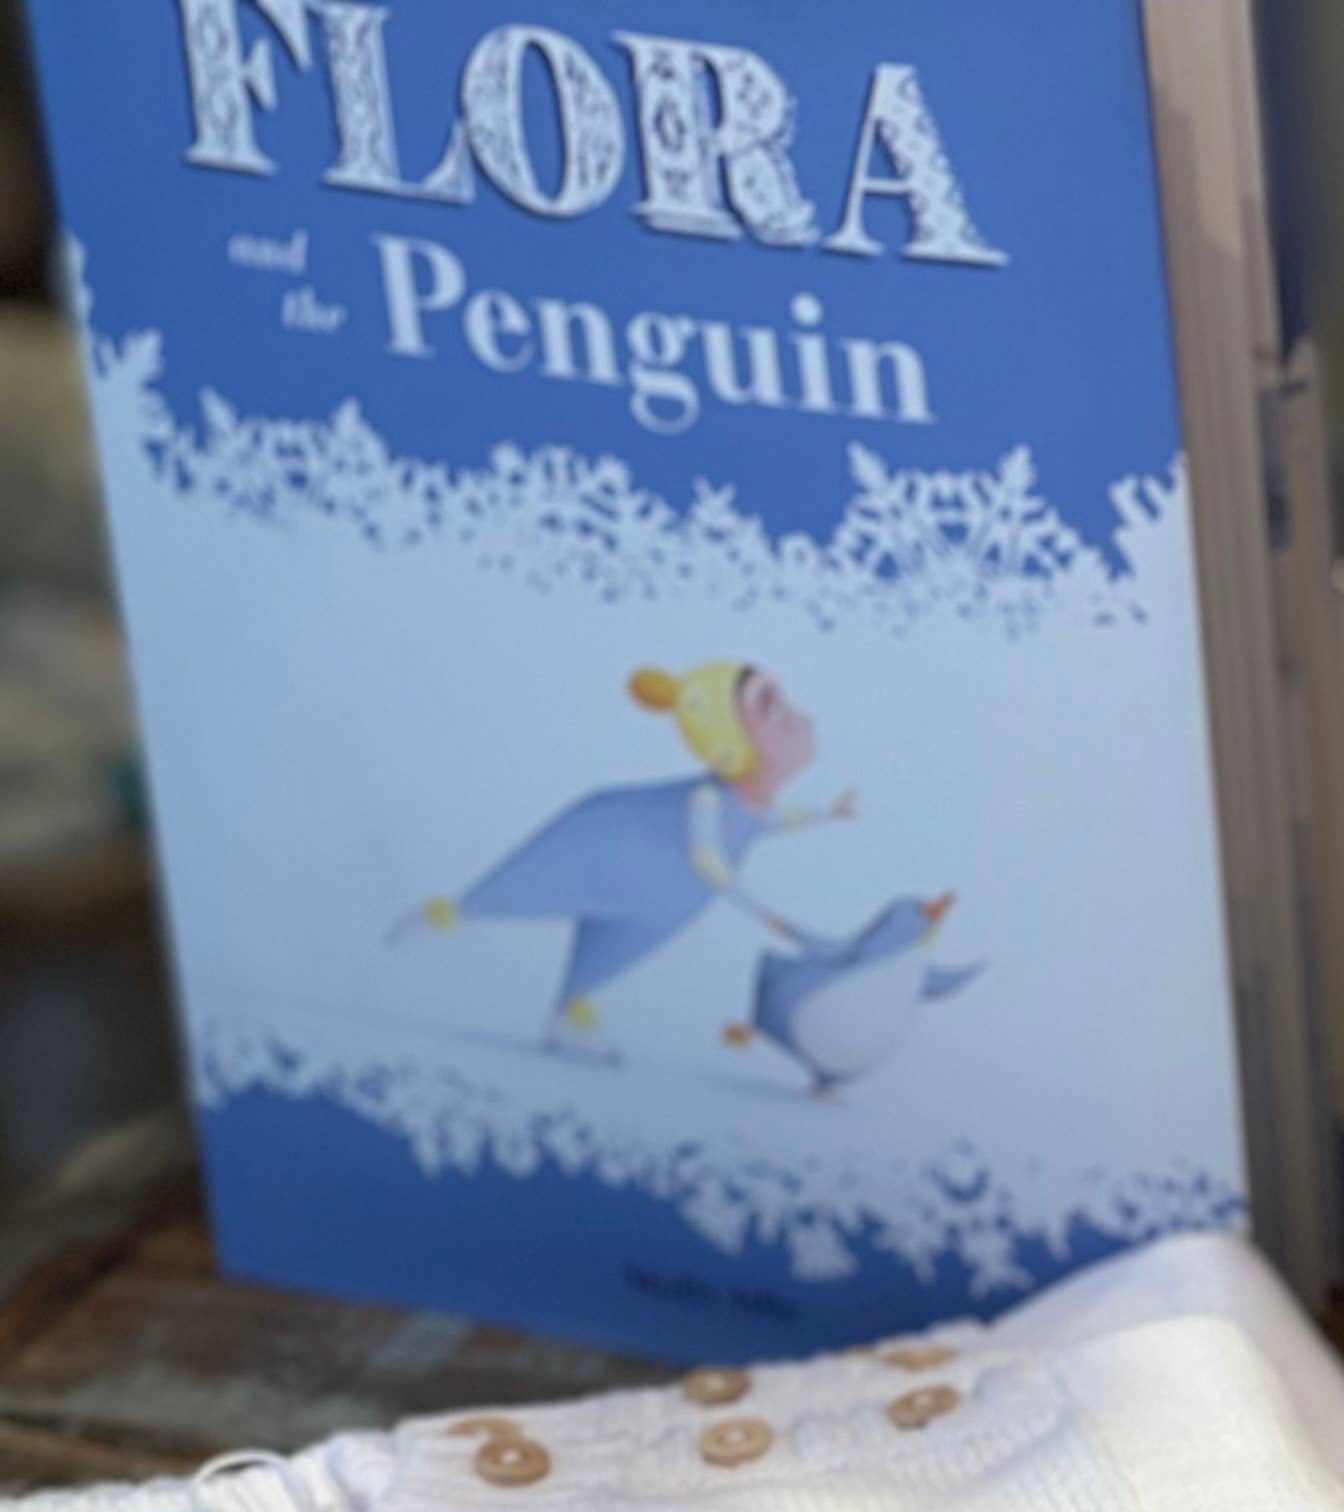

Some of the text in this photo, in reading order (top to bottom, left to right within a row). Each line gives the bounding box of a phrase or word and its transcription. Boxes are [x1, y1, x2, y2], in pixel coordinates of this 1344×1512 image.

[183, 0, 1009, 267] FLORA
[229, 228, 309, 275] and
[371, 231, 938, 433] Penguin
